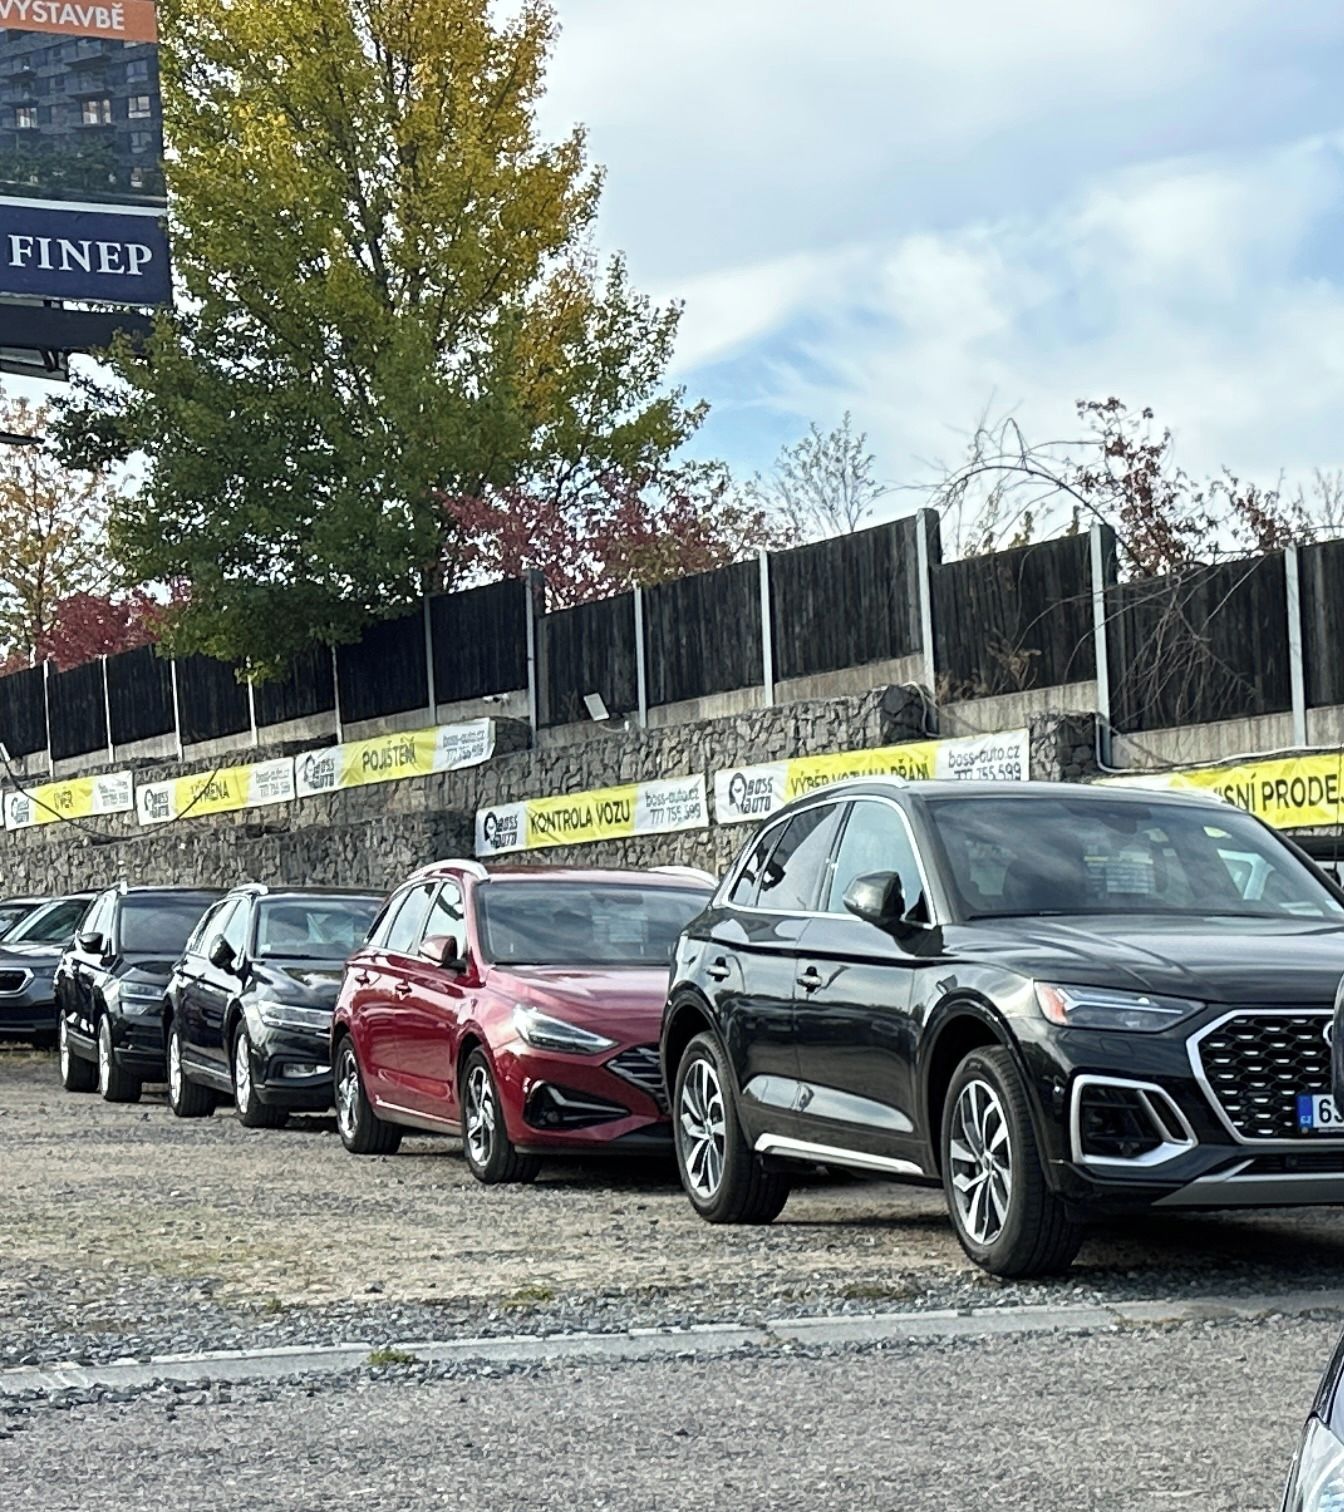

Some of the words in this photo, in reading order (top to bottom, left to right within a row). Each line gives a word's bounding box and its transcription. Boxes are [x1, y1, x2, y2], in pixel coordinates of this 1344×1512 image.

[8, 235, 152, 277] FINEP
[948, 743, 1021, 768] boss-auto.cz
[748, 777, 773, 795] BOSS
[744, 794, 771, 814] AUTO
[530, 806, 593, 834] KONTROLA
[598, 800, 630, 825] VOZU
[1319, 1098, 1343, 1123] 6
